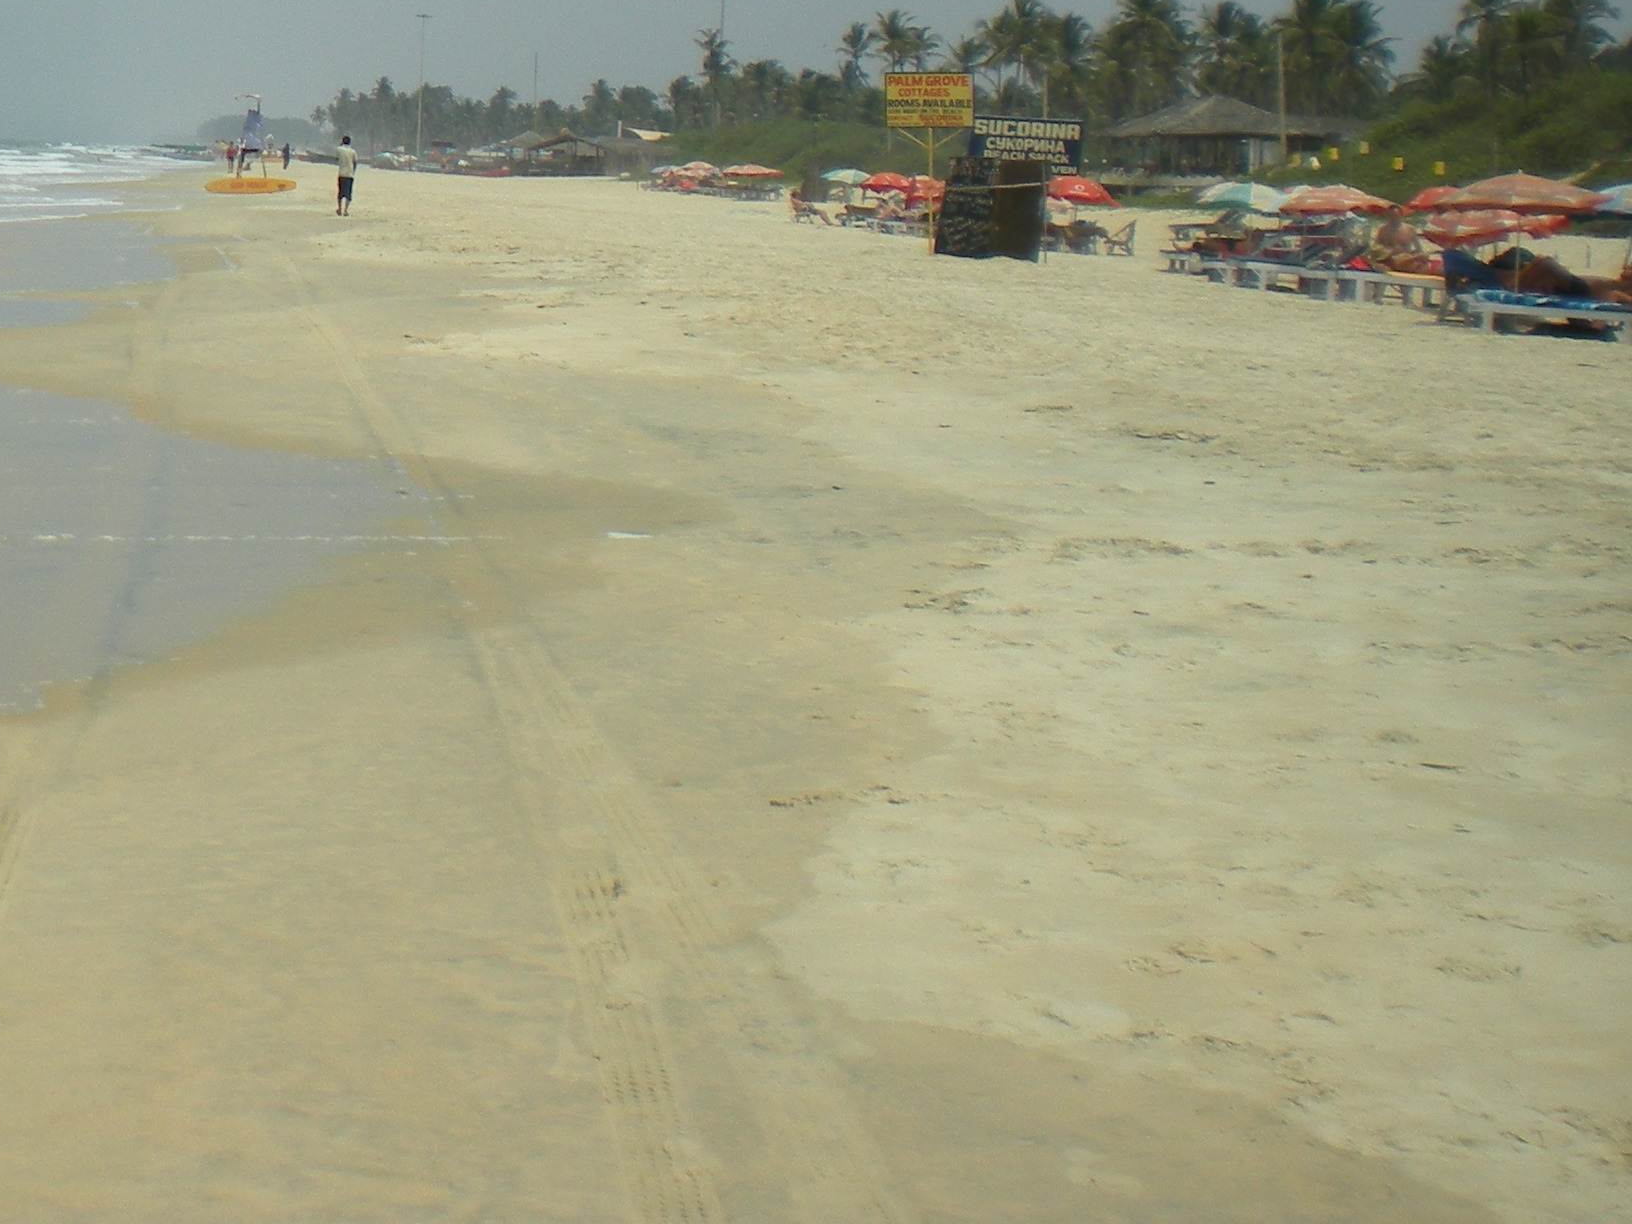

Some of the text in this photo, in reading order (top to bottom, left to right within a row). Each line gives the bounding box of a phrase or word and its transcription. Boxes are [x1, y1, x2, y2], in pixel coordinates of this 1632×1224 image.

[888, 76, 969, 87] PALM GROVE
[898, 88, 950, 97] COTTAGES
[887, 99, 973, 109] ROOMS AVAILABLE
[974, 119, 1082, 141] SUCORINA
[986, 137, 1066, 153] СУКОРИНА
[983, 150, 1070, 164] BEACH SHACK
